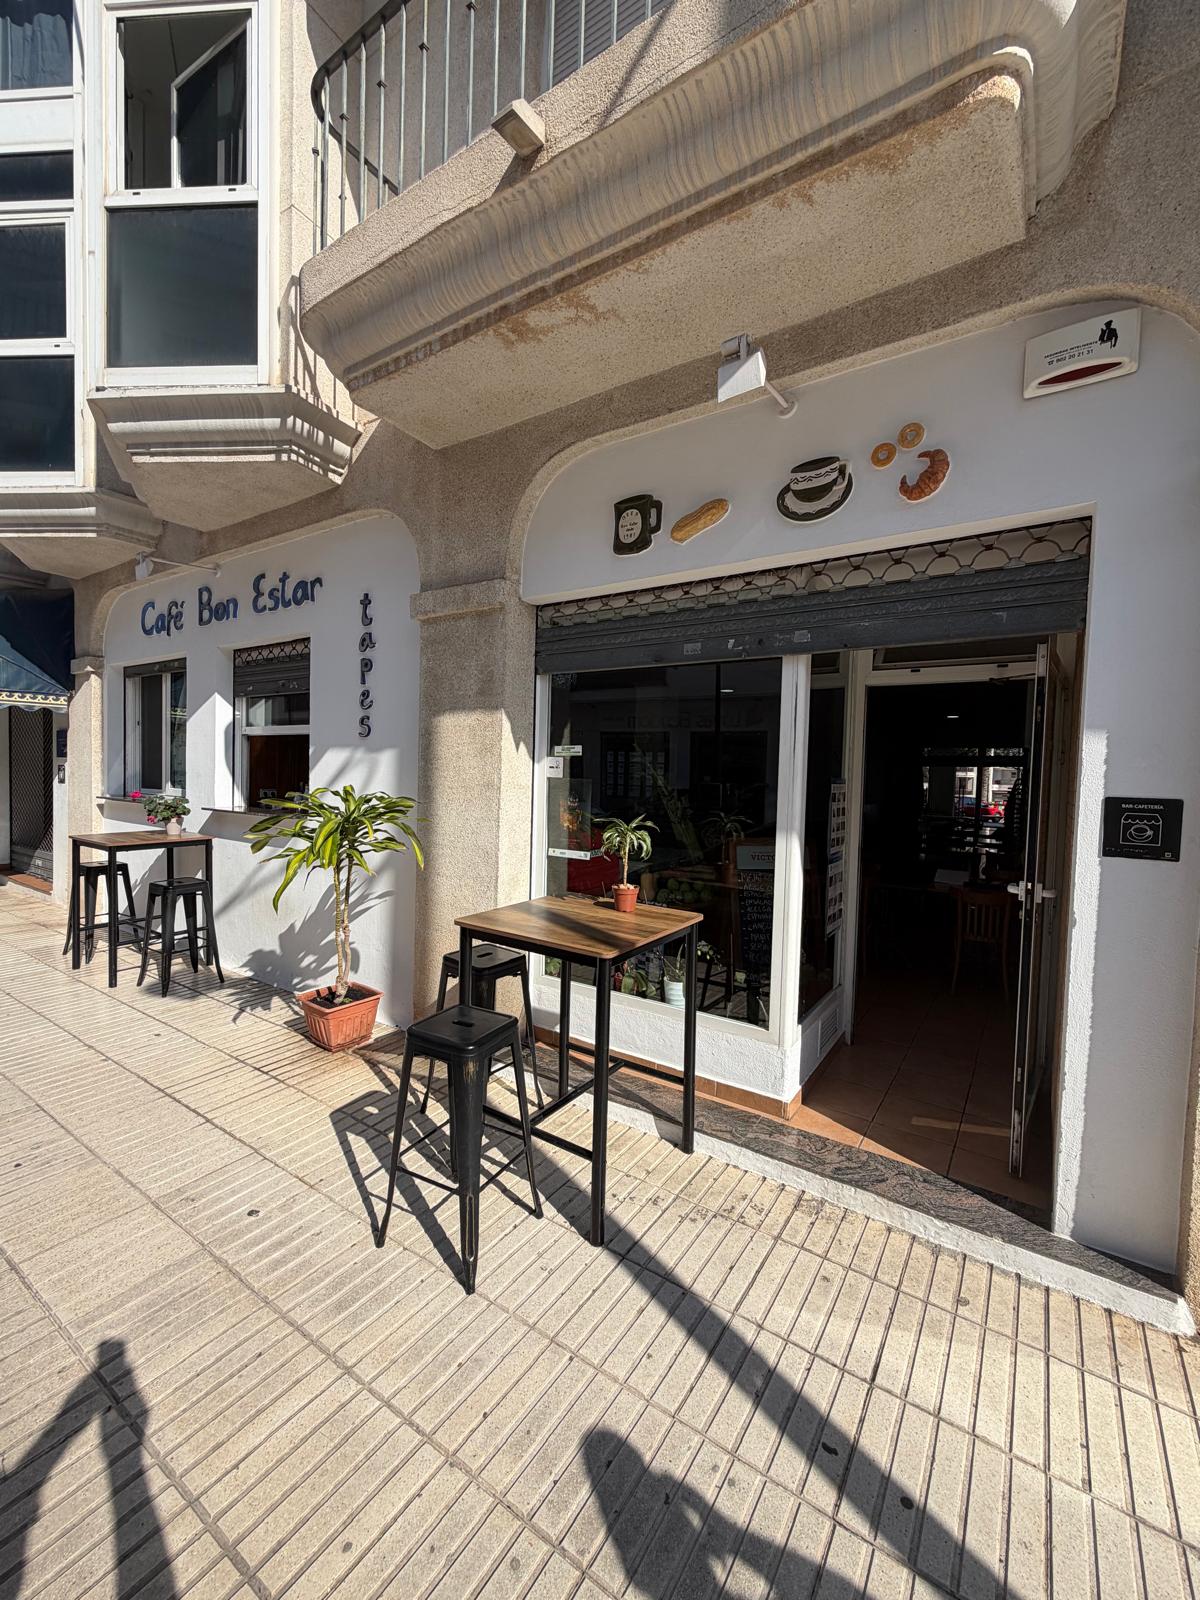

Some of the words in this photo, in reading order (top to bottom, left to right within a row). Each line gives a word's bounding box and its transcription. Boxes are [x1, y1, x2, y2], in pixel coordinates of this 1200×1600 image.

[140, 600, 186, 637] Café
[197, 585, 239, 627] Bon
[251, 571, 324, 614] Estar
[358, 592, 377, 738] tapes
